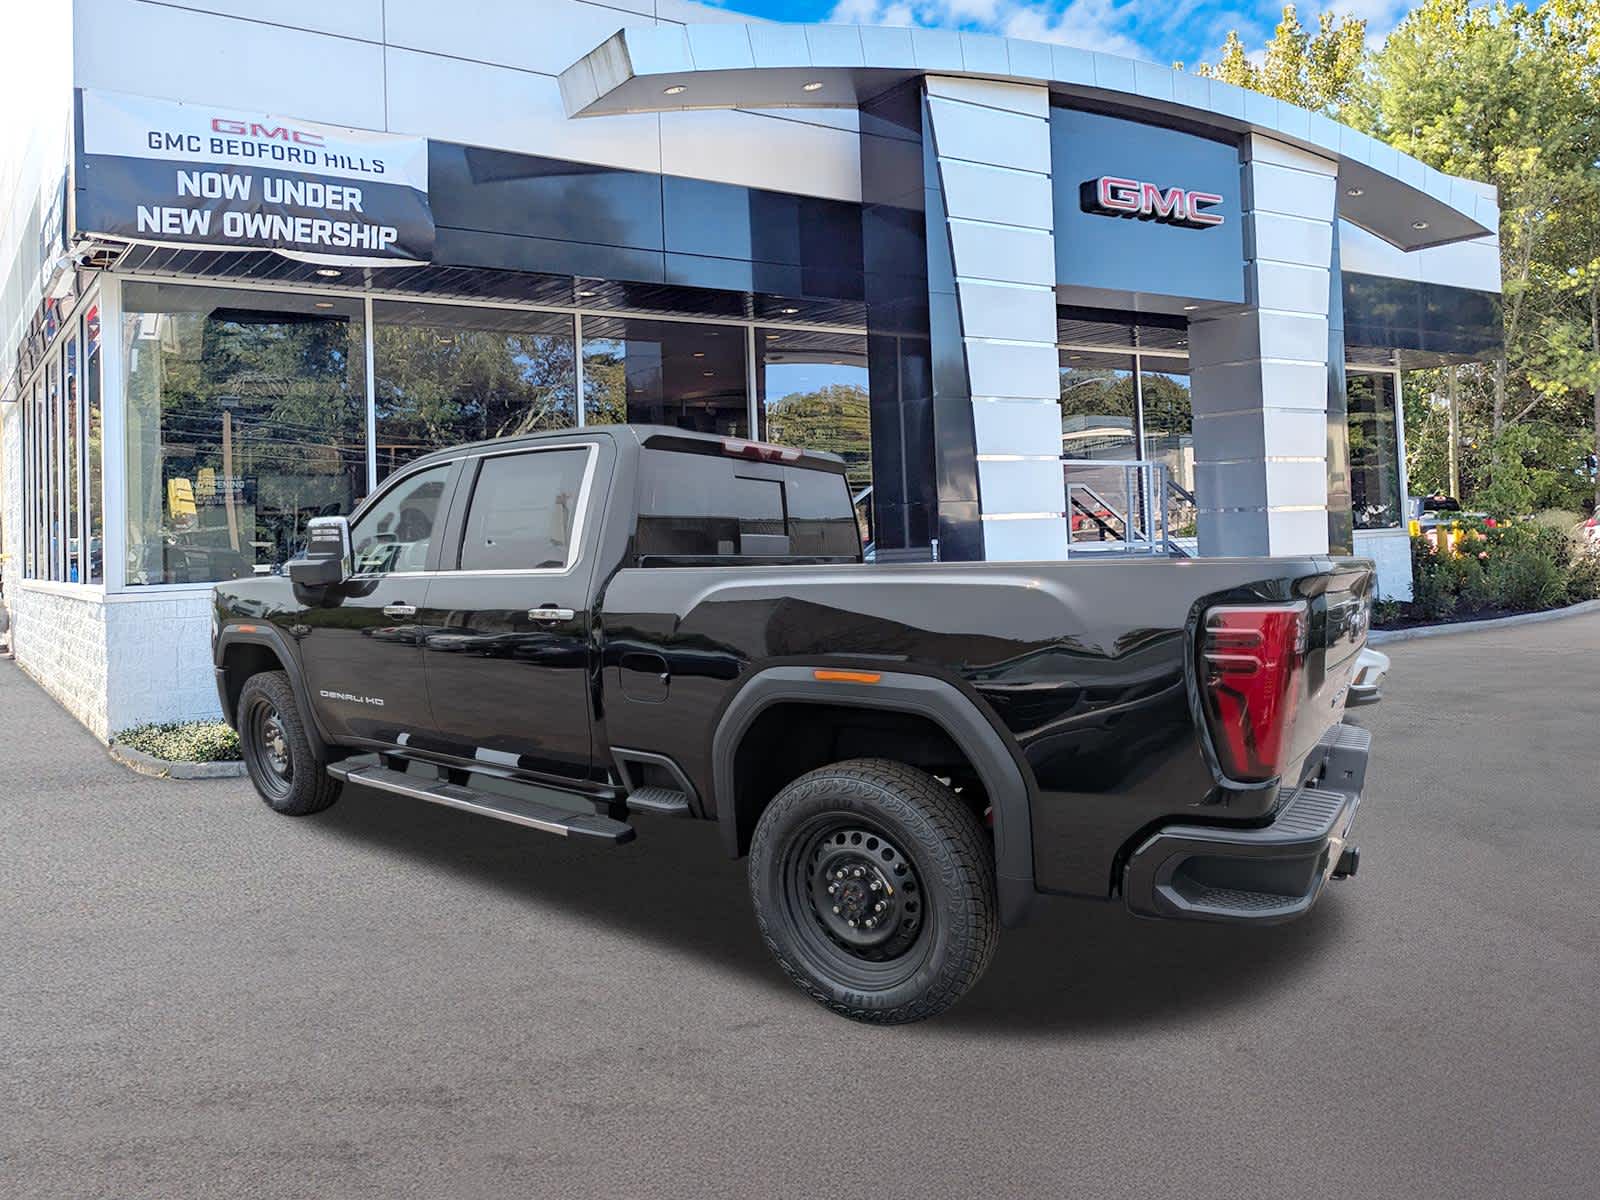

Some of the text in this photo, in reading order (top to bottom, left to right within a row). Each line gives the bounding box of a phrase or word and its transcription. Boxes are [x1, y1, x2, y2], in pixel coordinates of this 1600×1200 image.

[148, 131, 386, 175] GMC BEDFORD HILLS
[210, 117, 327, 148] GMC
[176, 170, 364, 213] NOW UNDER
[1096, 175, 1225, 225] GMC
[136, 205, 398, 250] NEW OWNERSHIP
[319, 690, 364, 703] DENALI
